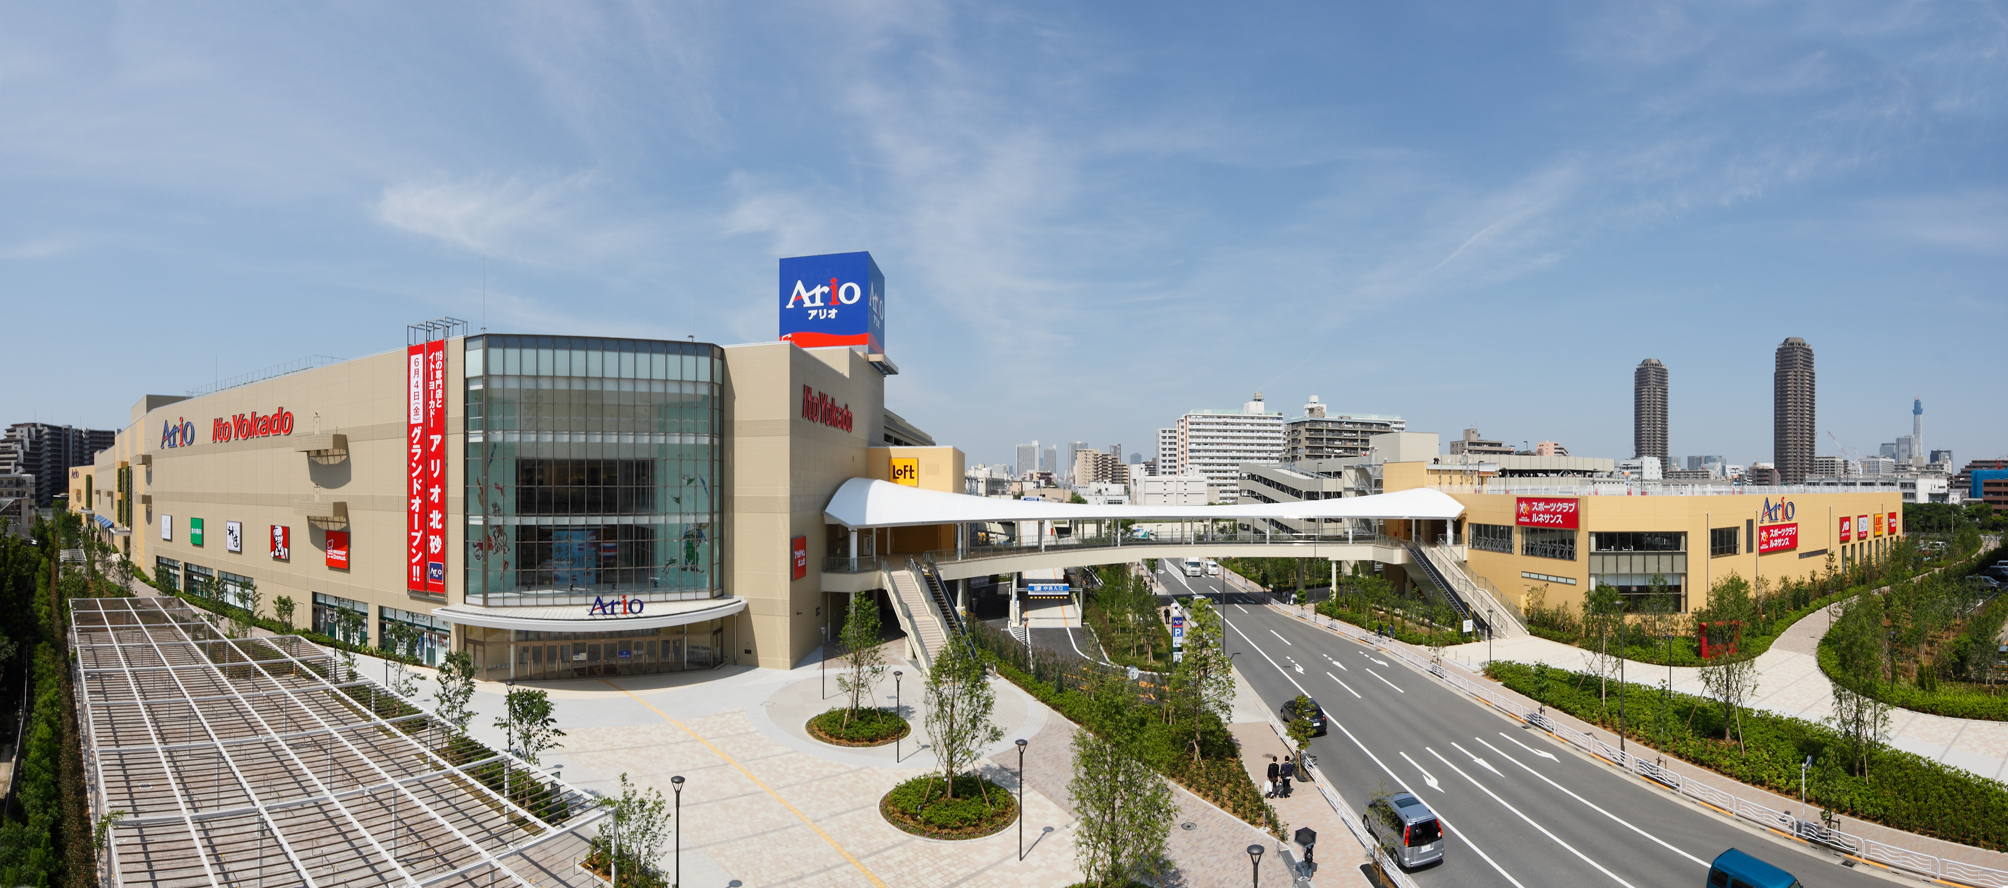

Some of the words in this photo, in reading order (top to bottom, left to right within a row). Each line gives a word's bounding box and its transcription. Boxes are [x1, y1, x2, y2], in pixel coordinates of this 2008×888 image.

[786, 277, 861, 309] Ario
[869, 281, 884, 320] Ario
[808, 308, 838, 320] アリオ
[160, 416, 195, 449] Ario
[231, 407, 294, 440] Yokado
[429, 434, 442, 554] アリオ北砂
[1532, 501, 1576, 513] スポーツクラブ
[1760, 496, 1795, 523] Ario
[1532, 513, 1563, 524] ルネサンス
[1769, 526, 1797, 538] スポーツクラブ
[1769, 537, 1790, 548] ルネサンス
[588, 594, 644, 616] Ario
[1175, 628, 1182, 637] P
